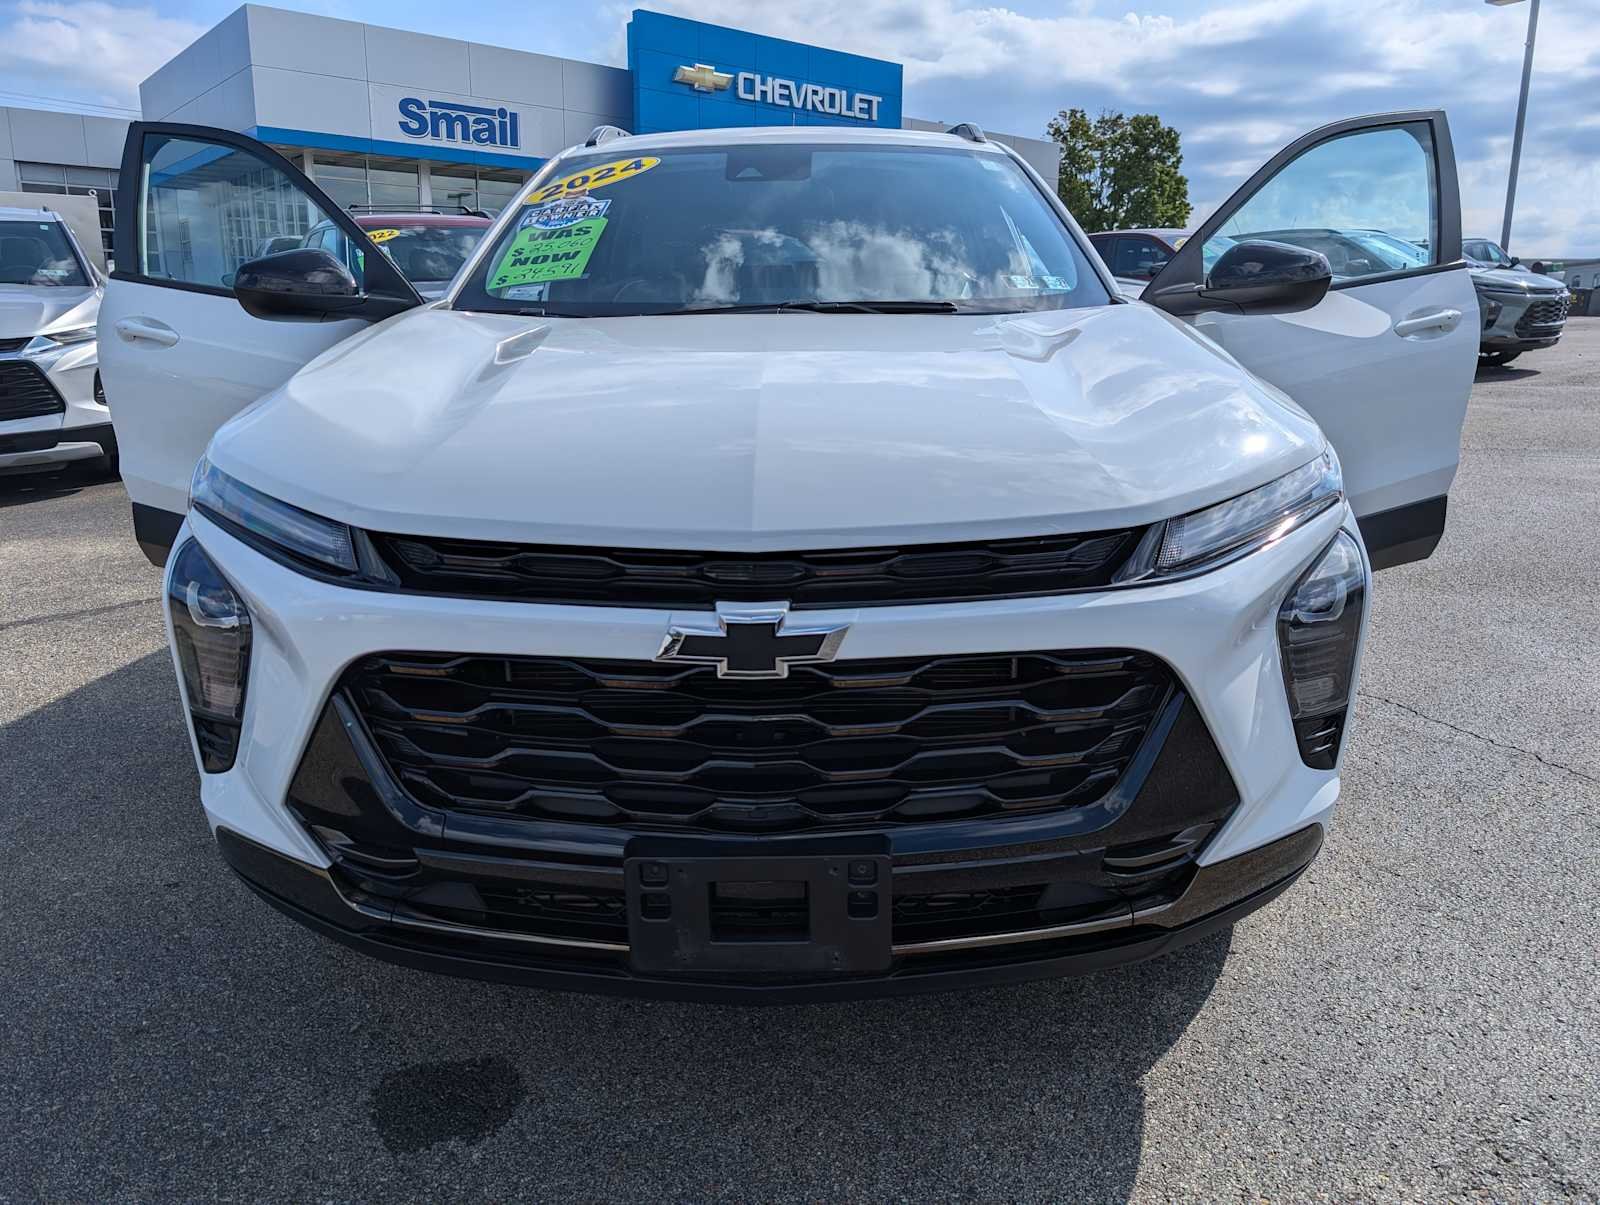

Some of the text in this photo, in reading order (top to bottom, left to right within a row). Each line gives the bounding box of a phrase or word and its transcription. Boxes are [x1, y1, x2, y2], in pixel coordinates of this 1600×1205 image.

[736, 71, 883, 121] CHEVROLET
[398, 97, 520, 148] Smail
[540, 157, 646, 201] 2024
[527, 226, 593, 242] WAS
[510, 250, 582, 267] NOW
